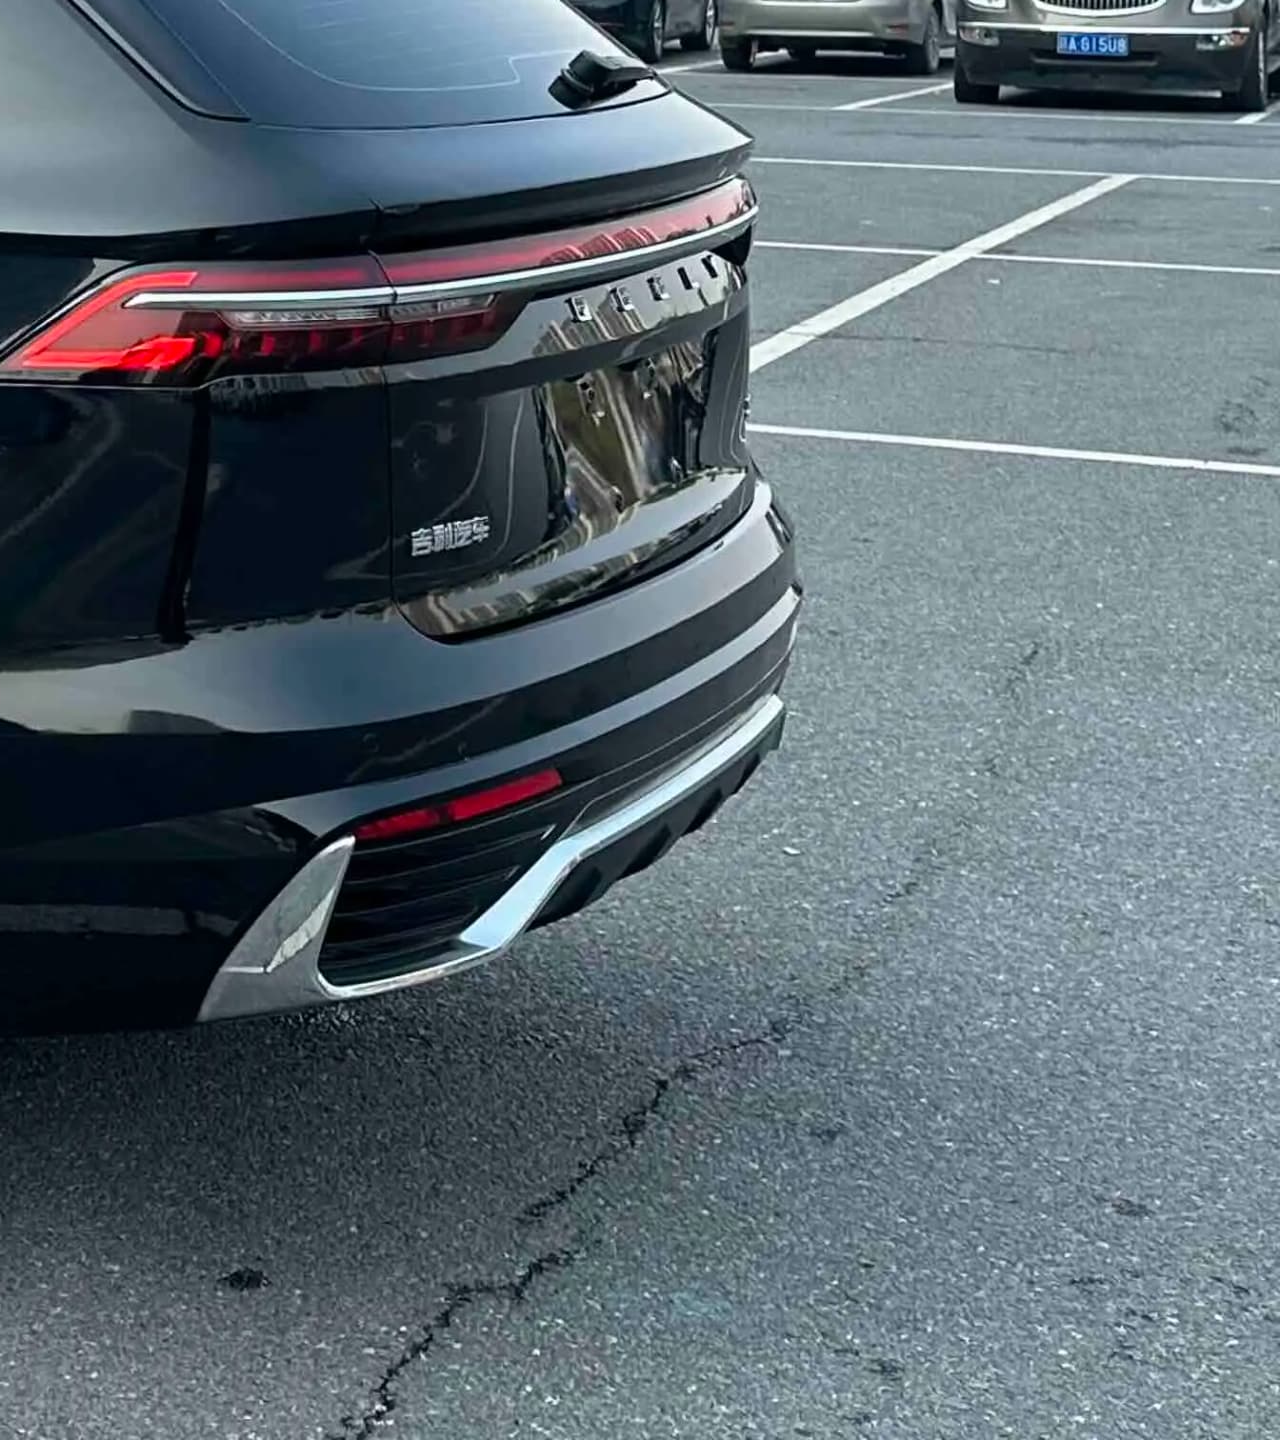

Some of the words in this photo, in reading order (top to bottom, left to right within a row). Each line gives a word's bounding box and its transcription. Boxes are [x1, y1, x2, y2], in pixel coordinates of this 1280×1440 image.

[565, 255, 722, 323] GEELY
[410, 515, 491, 557] 吉利汽车
